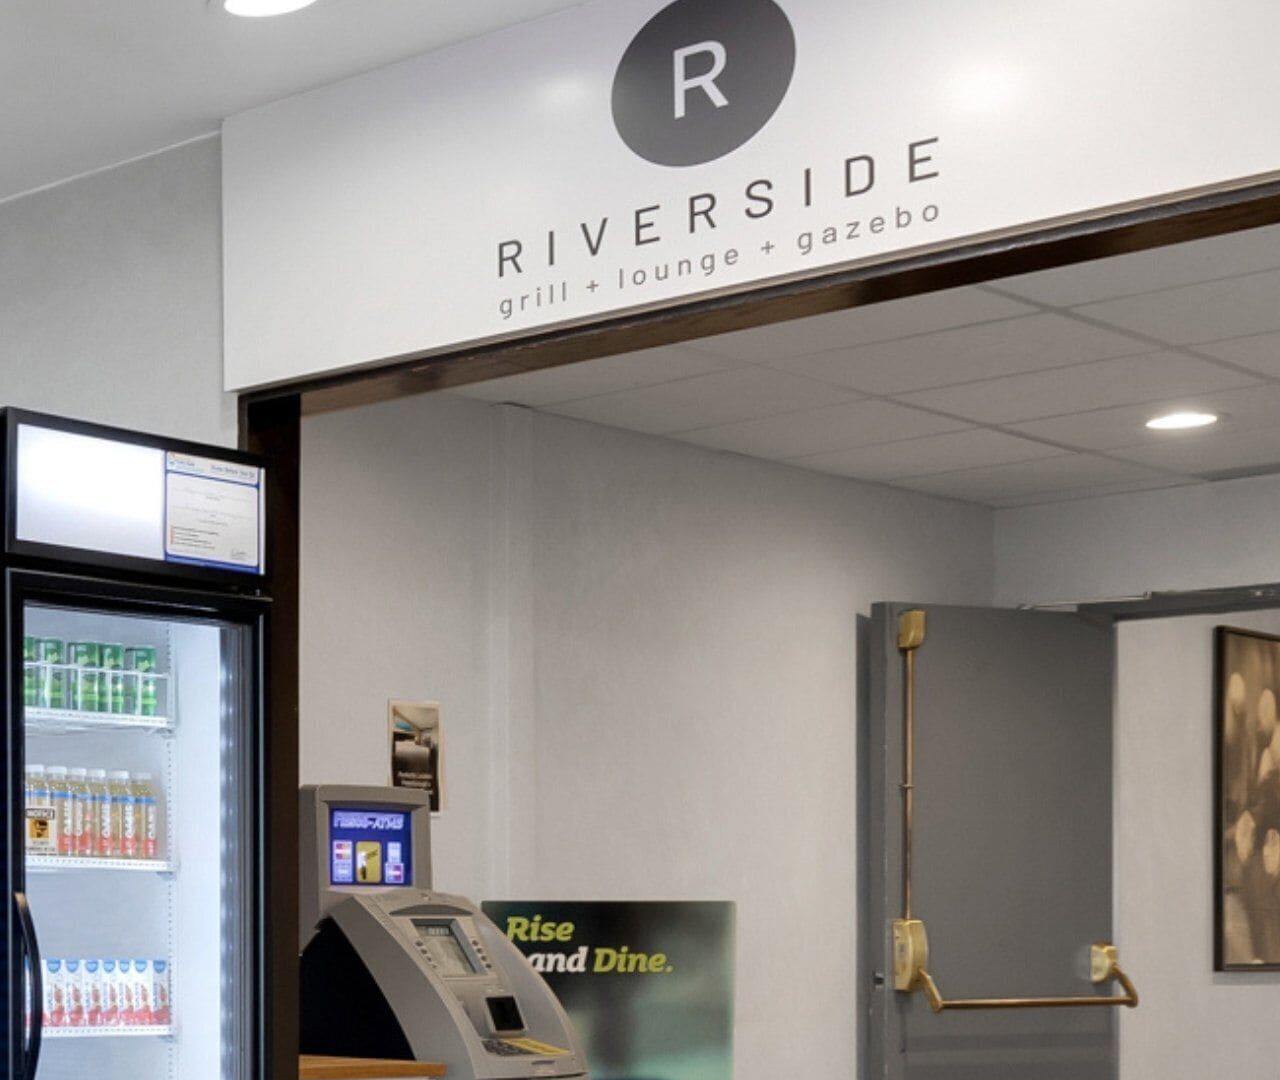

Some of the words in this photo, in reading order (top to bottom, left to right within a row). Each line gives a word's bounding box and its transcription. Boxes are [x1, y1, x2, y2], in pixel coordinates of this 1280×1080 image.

[673, 40, 729, 119] R
[497, 137, 940, 278] RIVERSIDE
[500, 281, 567, 319] grill
[618, 247, 740, 289] lounge
[797, 203, 940, 254] gazebo
[507, 914, 575, 942] Rise
[527, 946, 589, 973] and
[593, 946, 674, 973] Dine.
